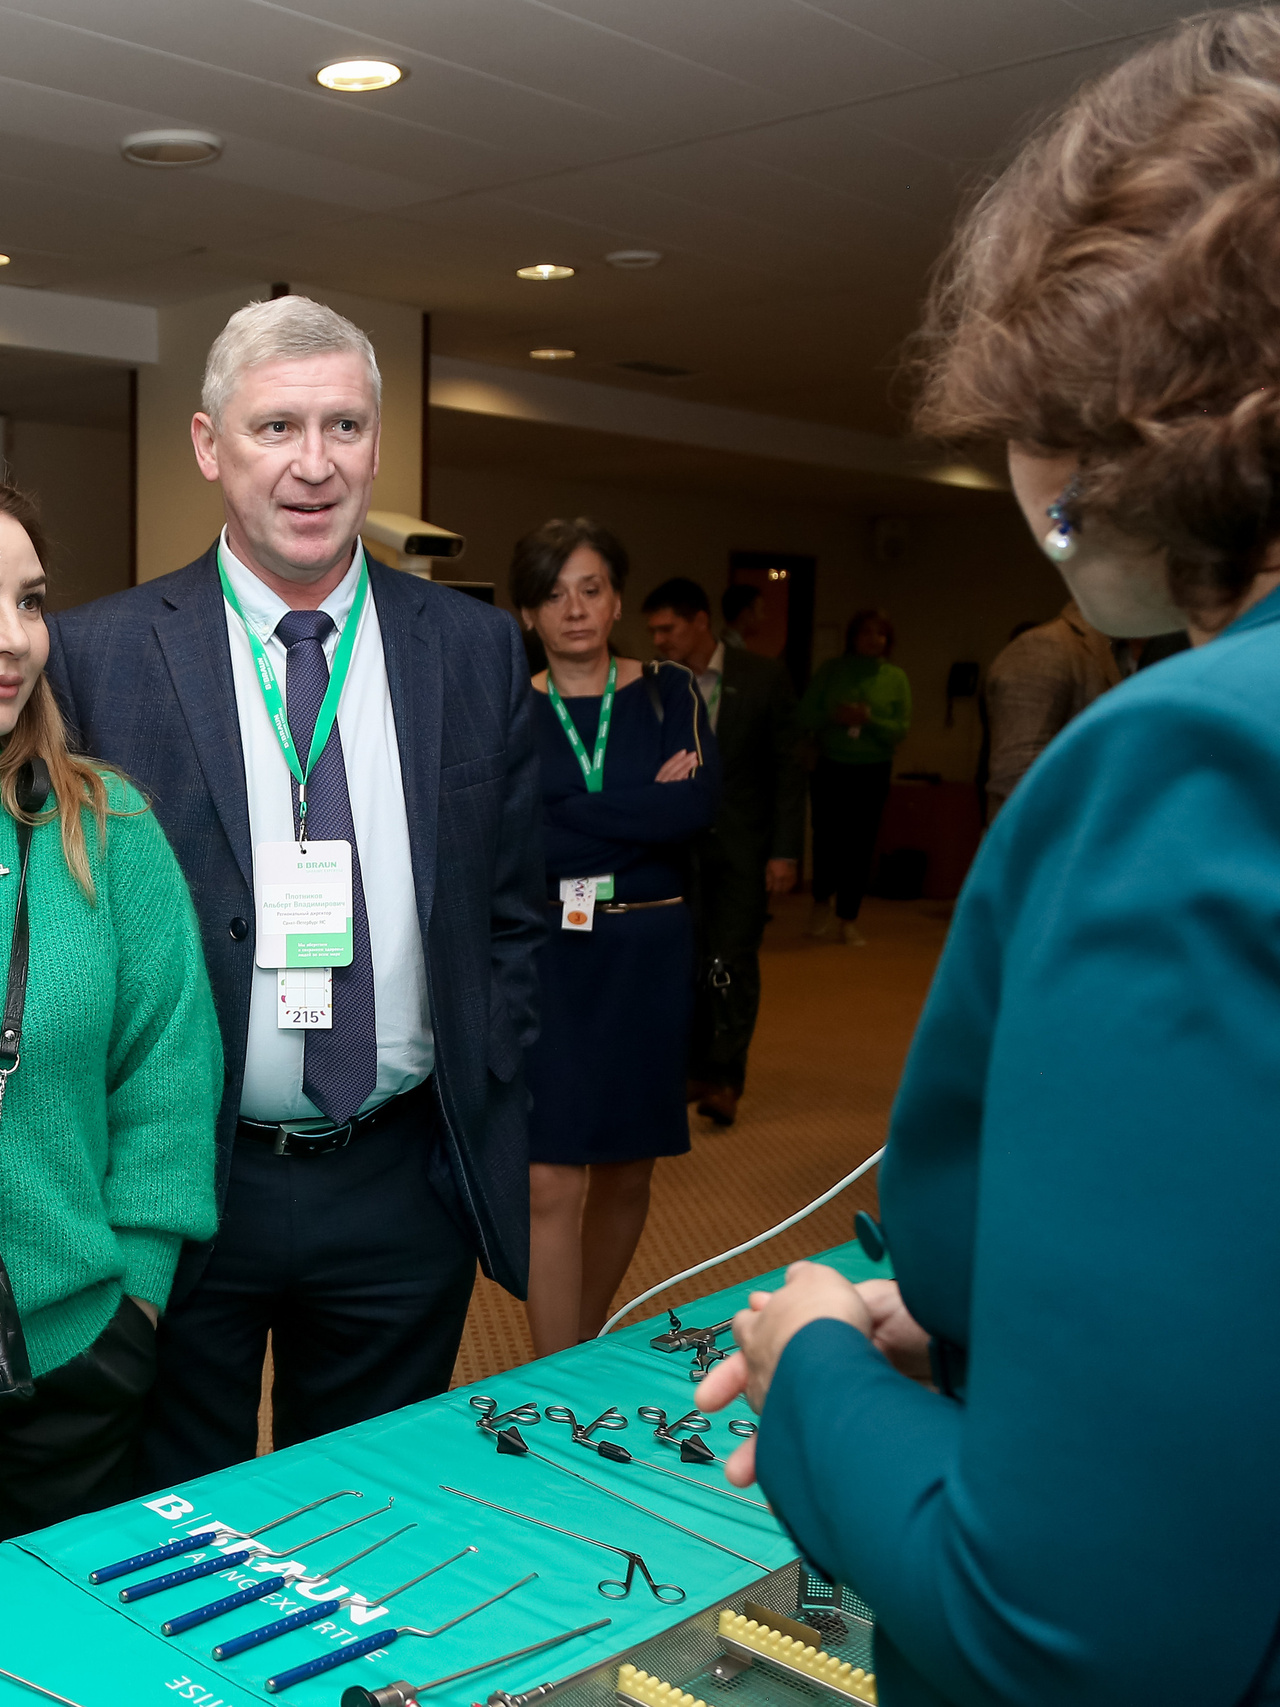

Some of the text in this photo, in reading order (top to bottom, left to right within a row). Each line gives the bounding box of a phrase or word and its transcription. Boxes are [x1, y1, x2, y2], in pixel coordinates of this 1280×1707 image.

[257, 657, 270, 684] BRAUN
[273, 713, 287, 743] BRAUN
[305, 861, 337, 869] BRAUN
[293, 901, 345, 909] Владимирович
[292, 1010, 319, 1023] 215
[142, 1493, 195, 1520] B
[259, 1592, 389, 1663] EXPRTIE
